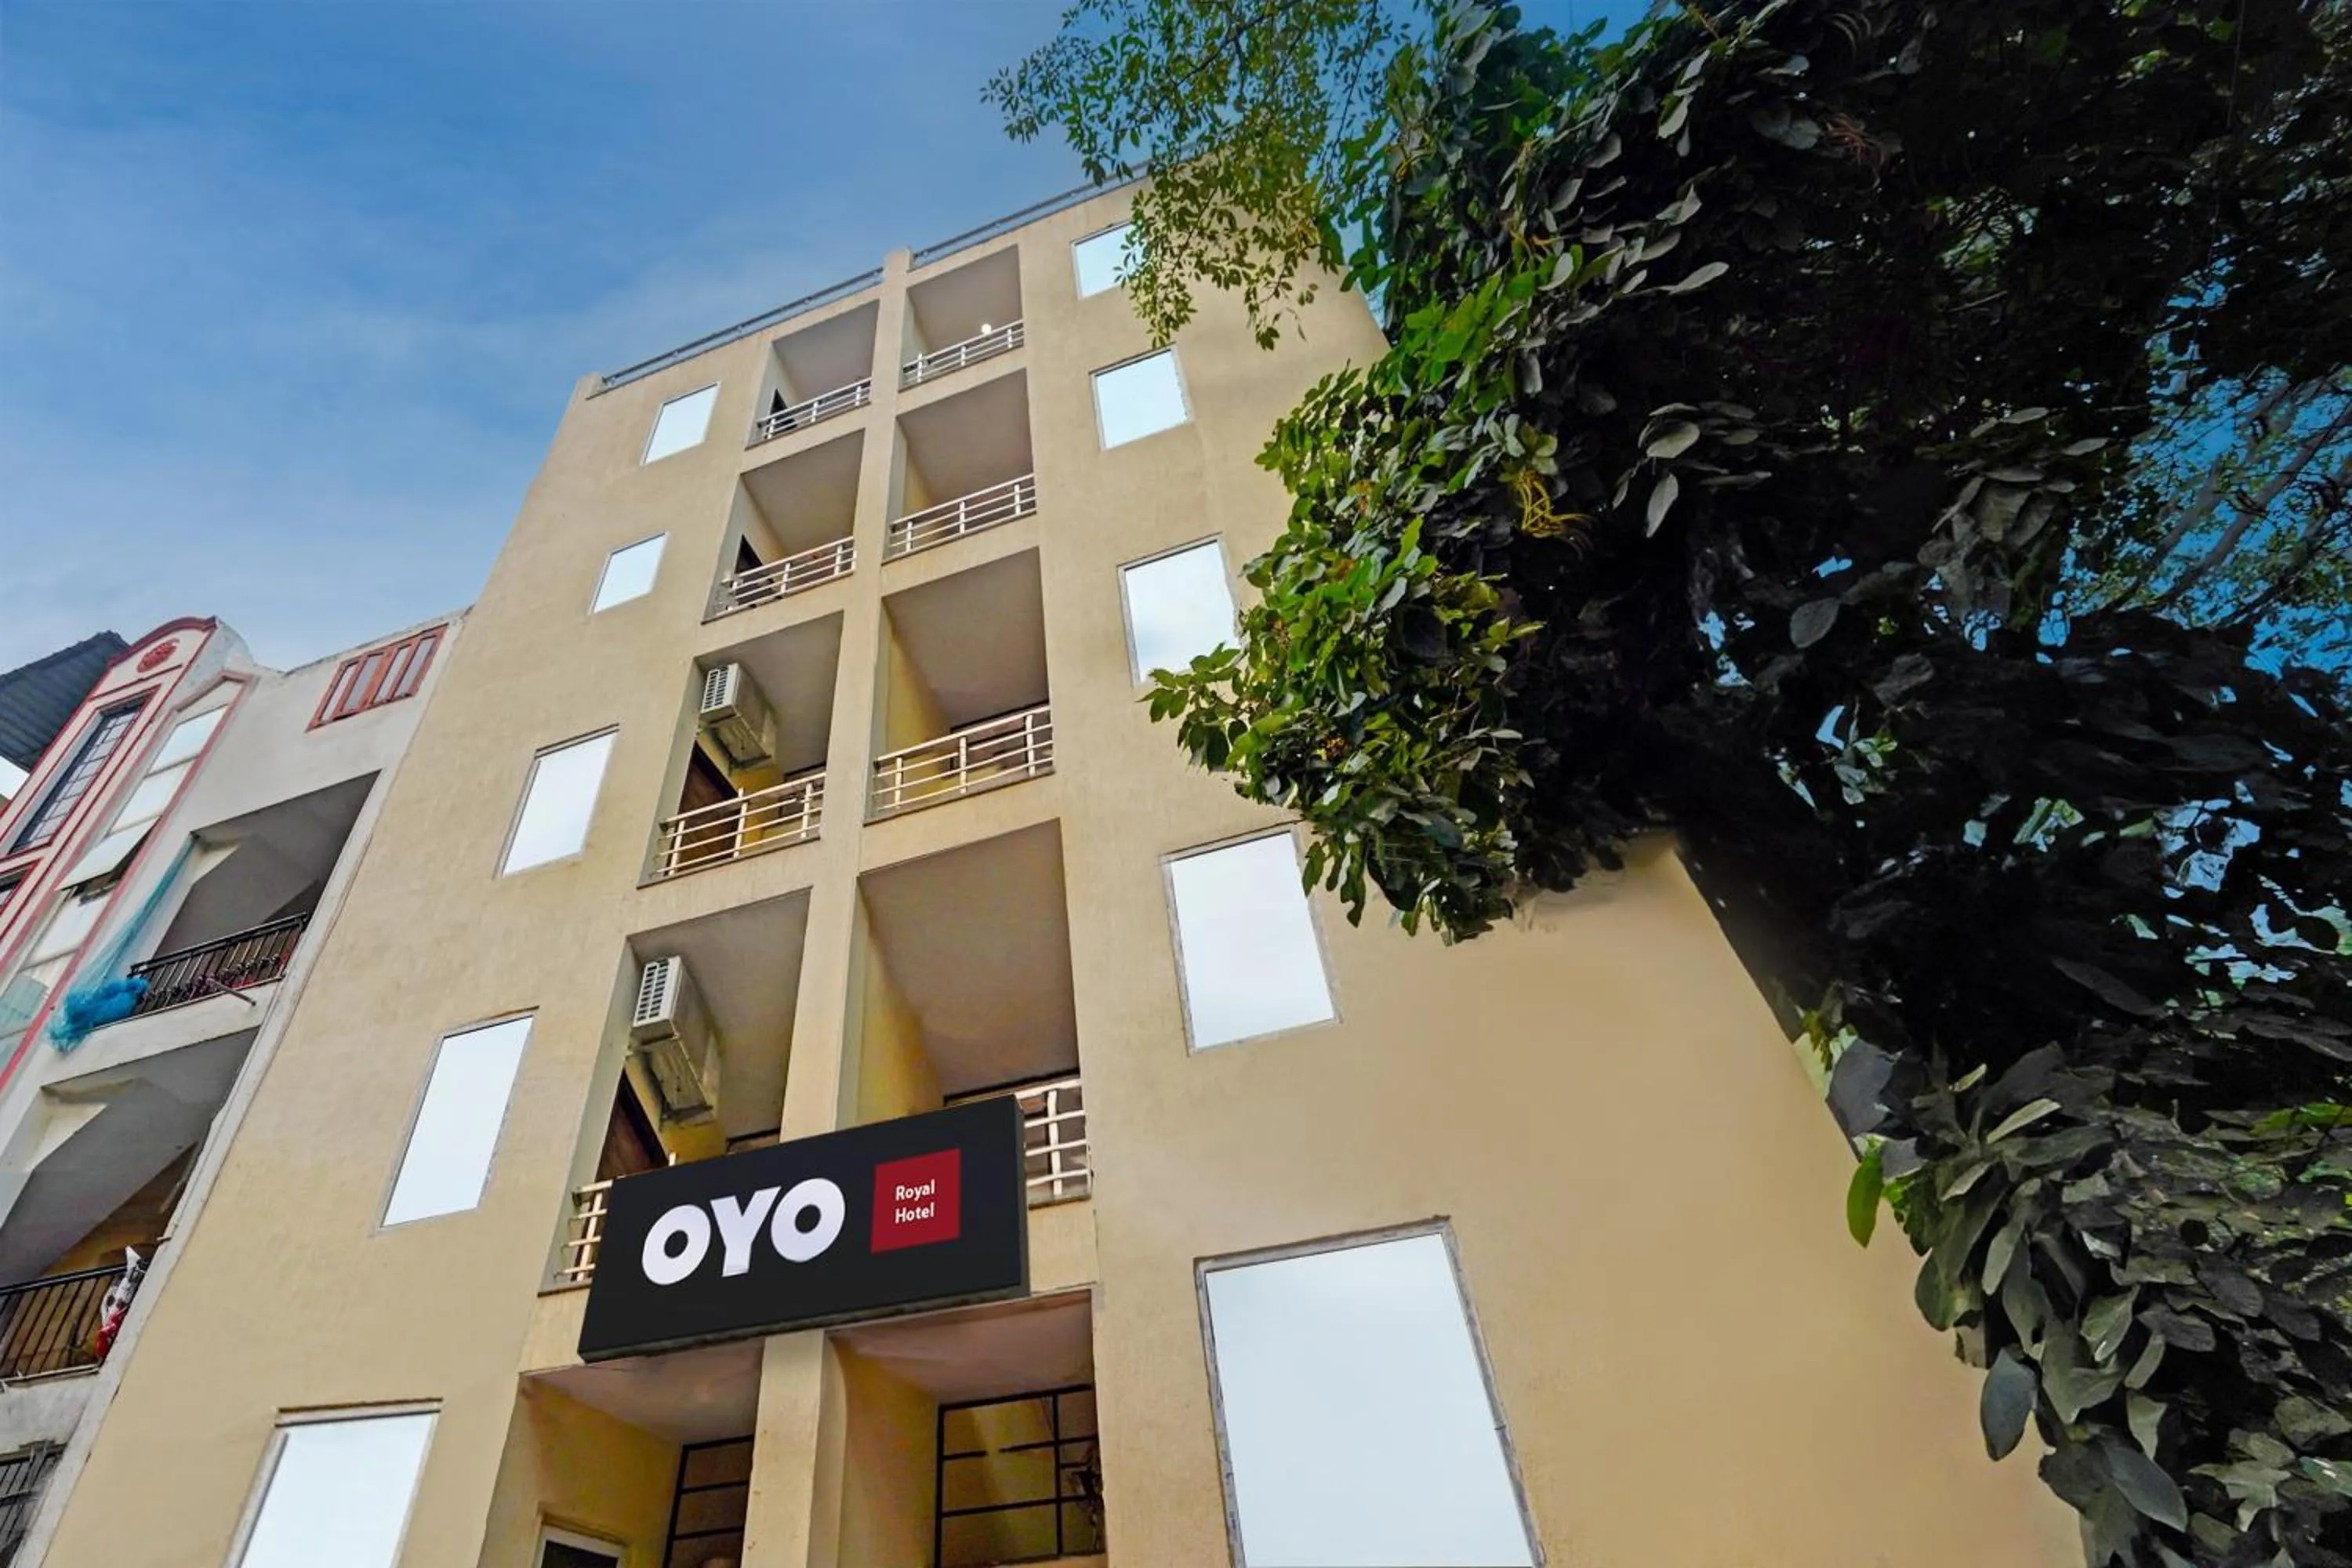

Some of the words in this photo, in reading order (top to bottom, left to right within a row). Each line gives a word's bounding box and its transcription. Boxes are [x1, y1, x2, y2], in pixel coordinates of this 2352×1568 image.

[895, 1179, 935, 1202] Royal
[895, 1202, 935, 1224] Hotel
[641, 1178, 846, 1287] OYO
